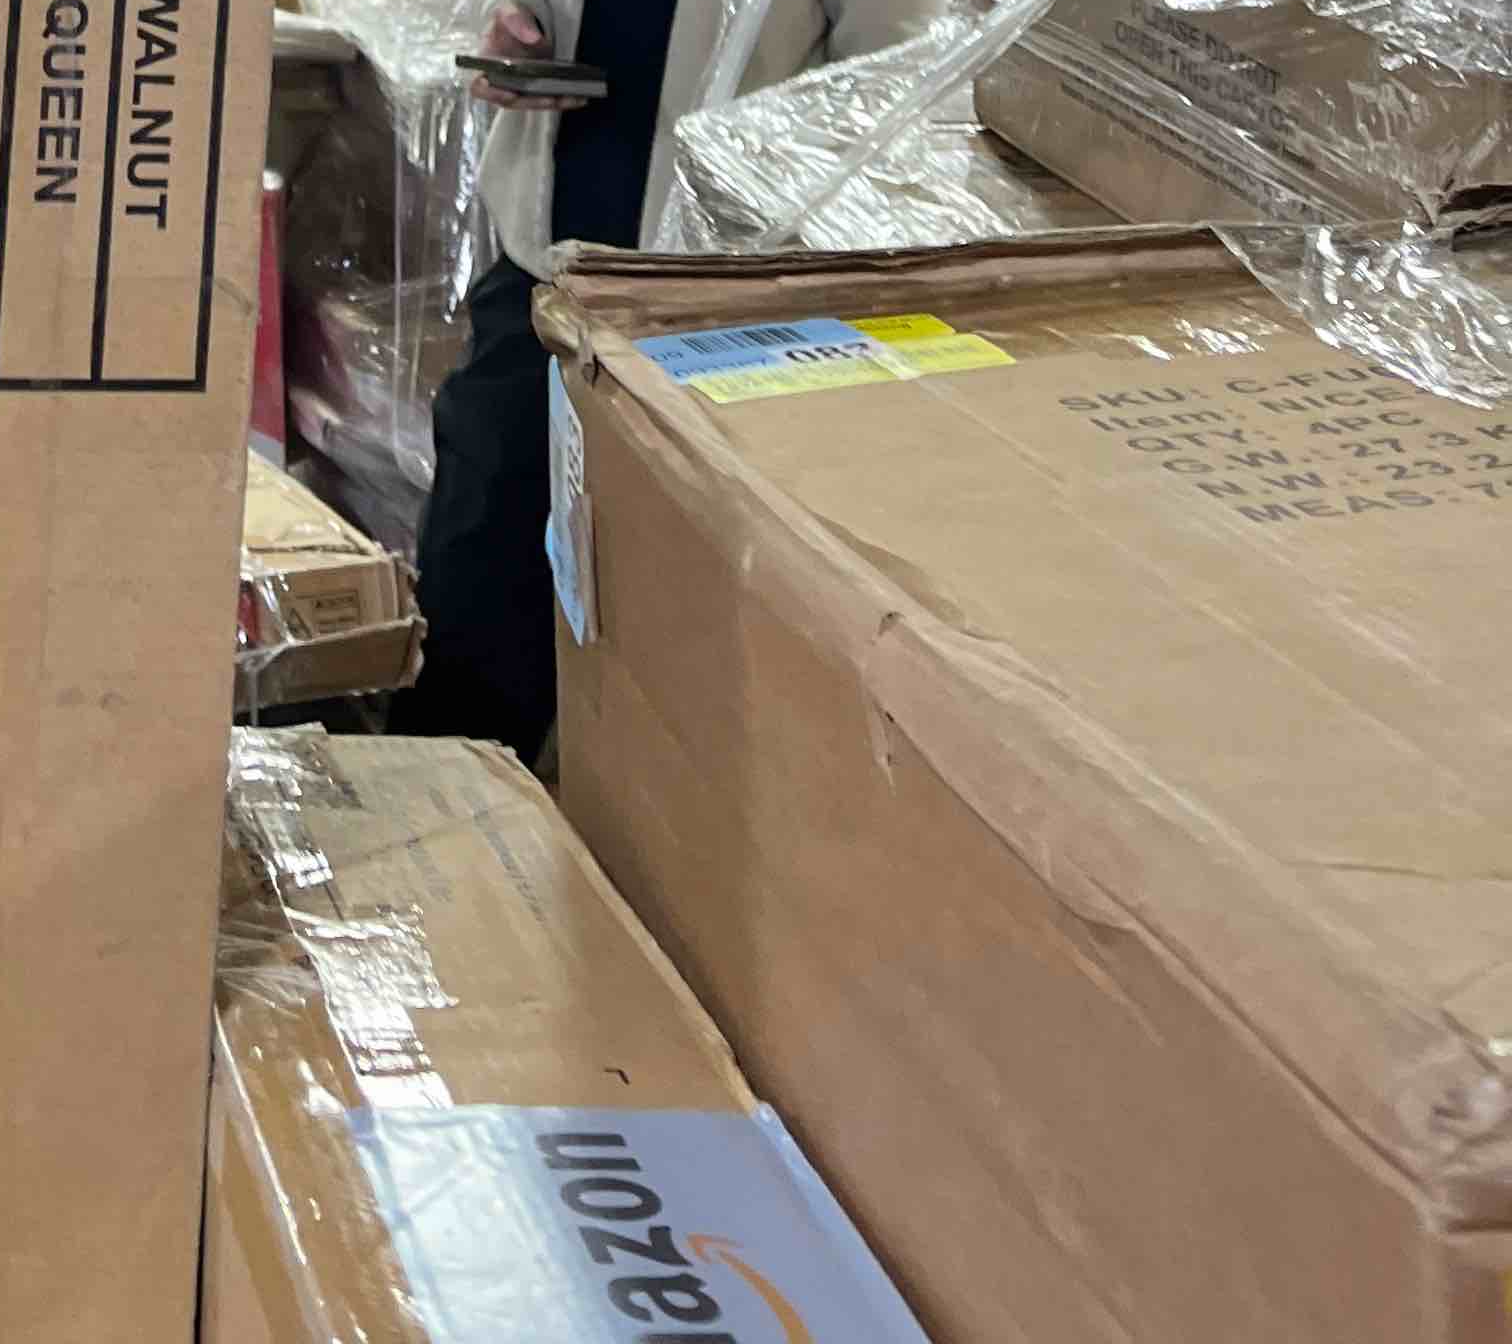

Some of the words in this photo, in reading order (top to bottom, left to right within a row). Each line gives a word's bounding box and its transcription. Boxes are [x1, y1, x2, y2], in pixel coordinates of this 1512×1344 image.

[1057, 386, 1213, 411] SKU:
[1126, 427, 1278, 453] QTY:
[1308, 411, 1424, 436] 4PC
[534, 1132, 738, 1344] azon
